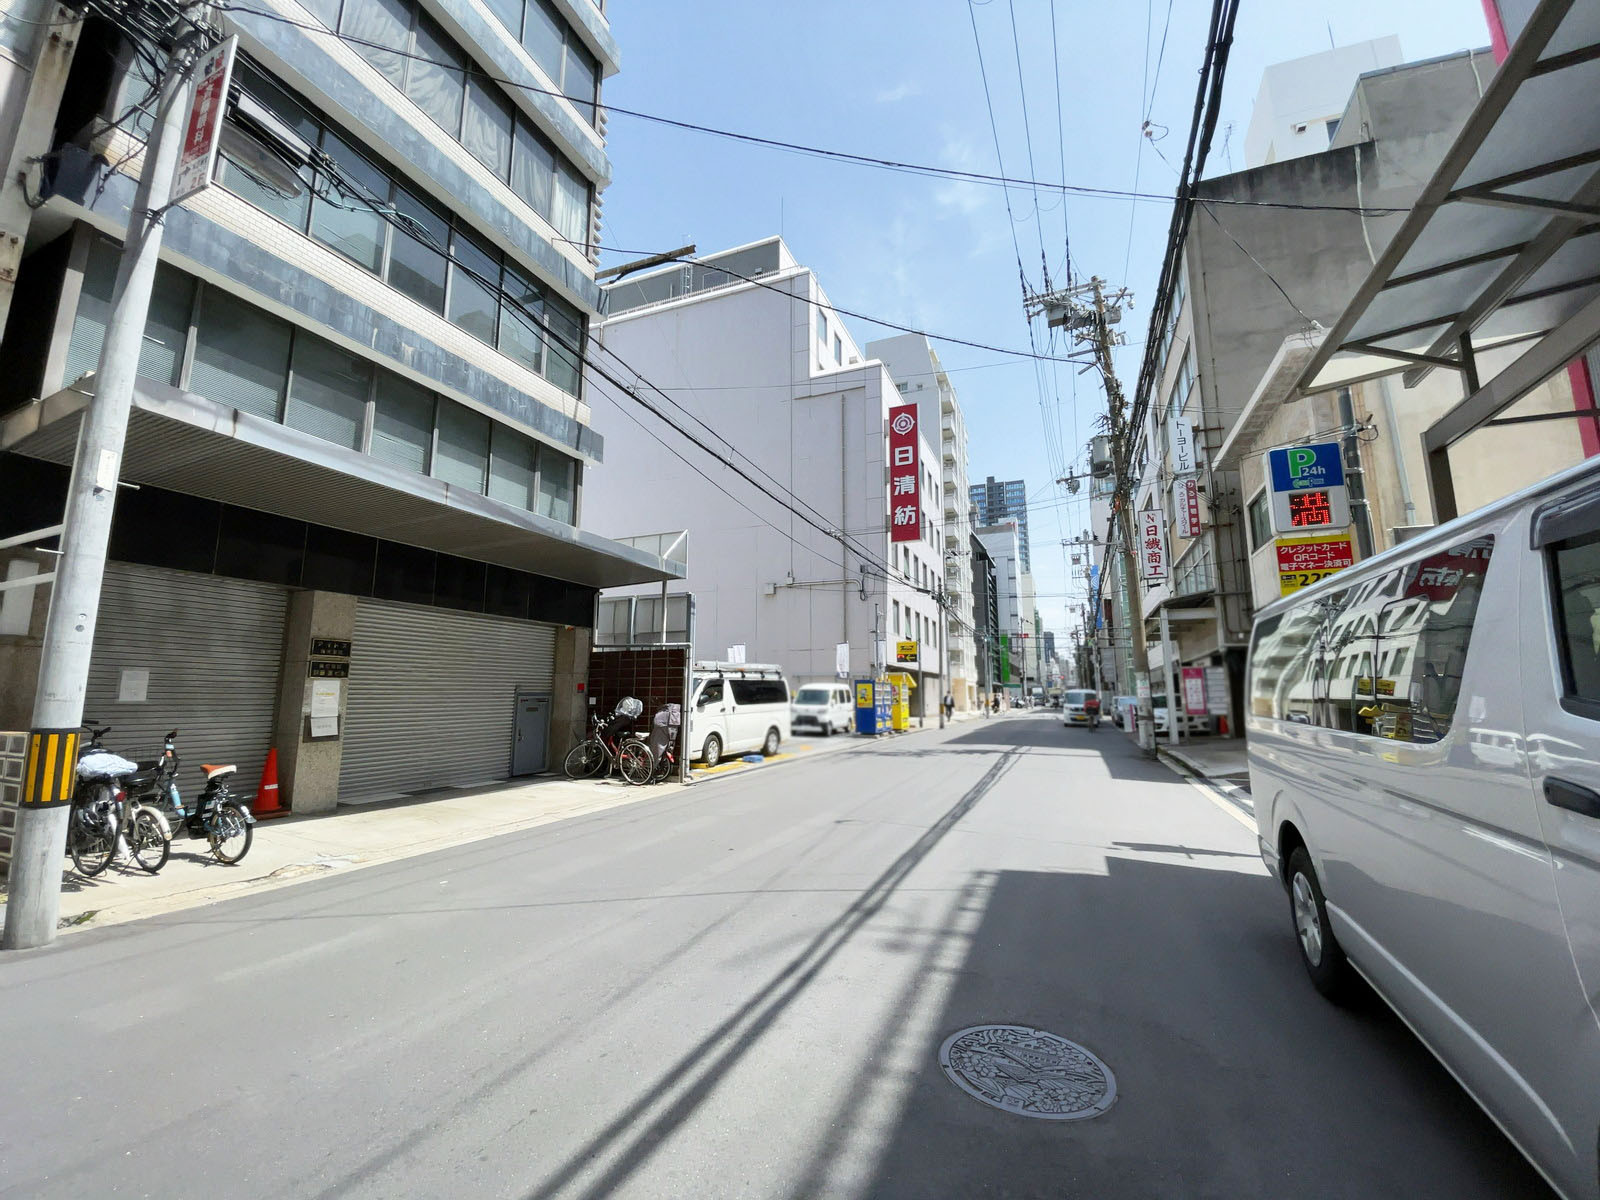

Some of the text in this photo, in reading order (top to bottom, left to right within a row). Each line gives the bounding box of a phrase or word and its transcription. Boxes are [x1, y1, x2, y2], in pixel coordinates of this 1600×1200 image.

[1176, 421, 1190, 470] トーヨービル
[1287, 448, 1317, 478] P
[1302, 466, 1326, 477] 24h
[893, 445, 917, 526] 日清紡
[1289, 492, 1330, 527] 満
[1280, 542, 1347, 554] クレジットカード
[1293, 552, 1336, 562] QRコード
[1280, 559, 1352, 571] 電子マネー決済可
